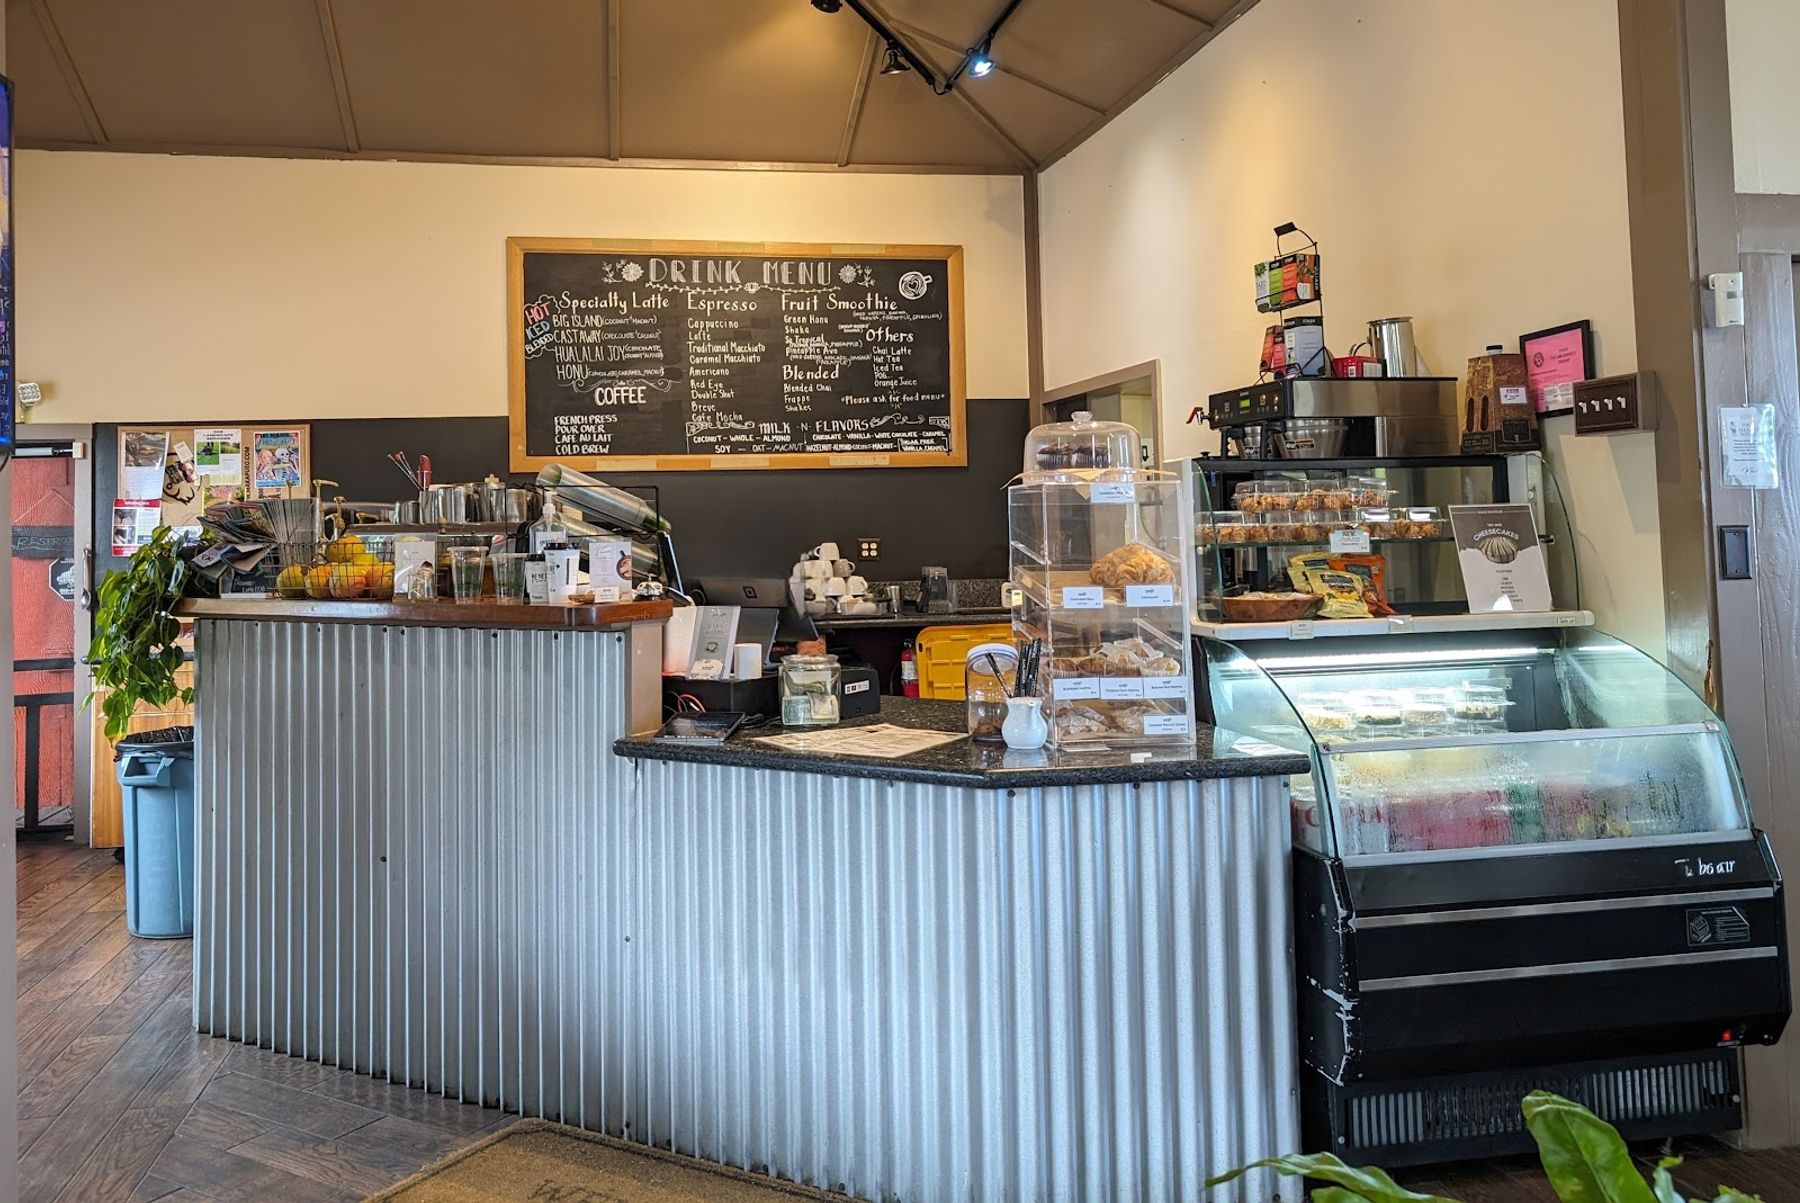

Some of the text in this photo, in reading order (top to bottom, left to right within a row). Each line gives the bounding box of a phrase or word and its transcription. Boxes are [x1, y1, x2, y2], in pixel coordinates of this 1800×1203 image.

[649, 258, 832, 286] DRINK MENU
[559, 290, 670, 315] Specialty Latte
[687, 291, 758, 317] Espresso
[781, 292, 898, 311] Fruit Smoothie
[524, 301, 551, 325] HOT
[552, 314, 570, 328] BIG
[571, 314, 603, 328] ISLAND
[687, 317, 740, 332] Cappuccino
[783, 314, 807, 325] Green
[525, 320, 551, 340] ICED
[688, 330, 711, 341] Latte
[784, 325, 810, 335] Shaka
[865, 326, 914, 343] Others
[553, 329, 601, 344] CASTAWAY
[794, 333, 824, 344] Tropical
[524, 333, 554, 355] BLENDED
[686, 341, 766, 353] Traditional Macchiato
[554, 345, 625, 362] HUALALAI JOY
[785, 347, 821, 357] Pineapple
[872, 346, 912, 356] Chai Latte
[689, 353, 761, 365] Caramel Macchiato
[873, 355, 901, 363] Hot Tea
[556, 364, 588, 380] HONU
[689, 366, 730, 377] Americano
[782, 364, 840, 381] Blended
[872, 364, 904, 372] Iced Tea
[689, 379, 724, 392] Red Eye
[783, 383, 832, 393] Blended Chai
[874, 377, 918, 390] Orange Juice
[594, 386, 647, 406] COFFEE
[690, 388, 736, 400] Double Shot
[784, 394, 811, 404] Frappe
[873, 394, 887, 404] ask
[889, 394, 900, 403] for
[902, 393, 919, 402] food
[690, 400, 716, 412] Breve
[785, 403, 812, 412] Shakes
[553, 414, 618, 427] FRENCH PRESS
[691, 410, 743, 422] Cafe Mocha
[554, 424, 606, 435] POUR OVER
[758, 422, 791, 435] MILK
[815, 419, 869, 432] FLAVORS
[554, 433, 613, 444] CAFE AU LAIT
[693, 435, 722, 443] COCONUT
[729, 434, 755, 442] WHOLE
[812, 433, 842, 441] CHOCOLATE
[846, 432, 872, 440] VANILLA
[555, 444, 610, 456] COLD BREW
[714, 445, 731, 453] SOY
[1473, 527, 1519, 541] CHEESECAKES
